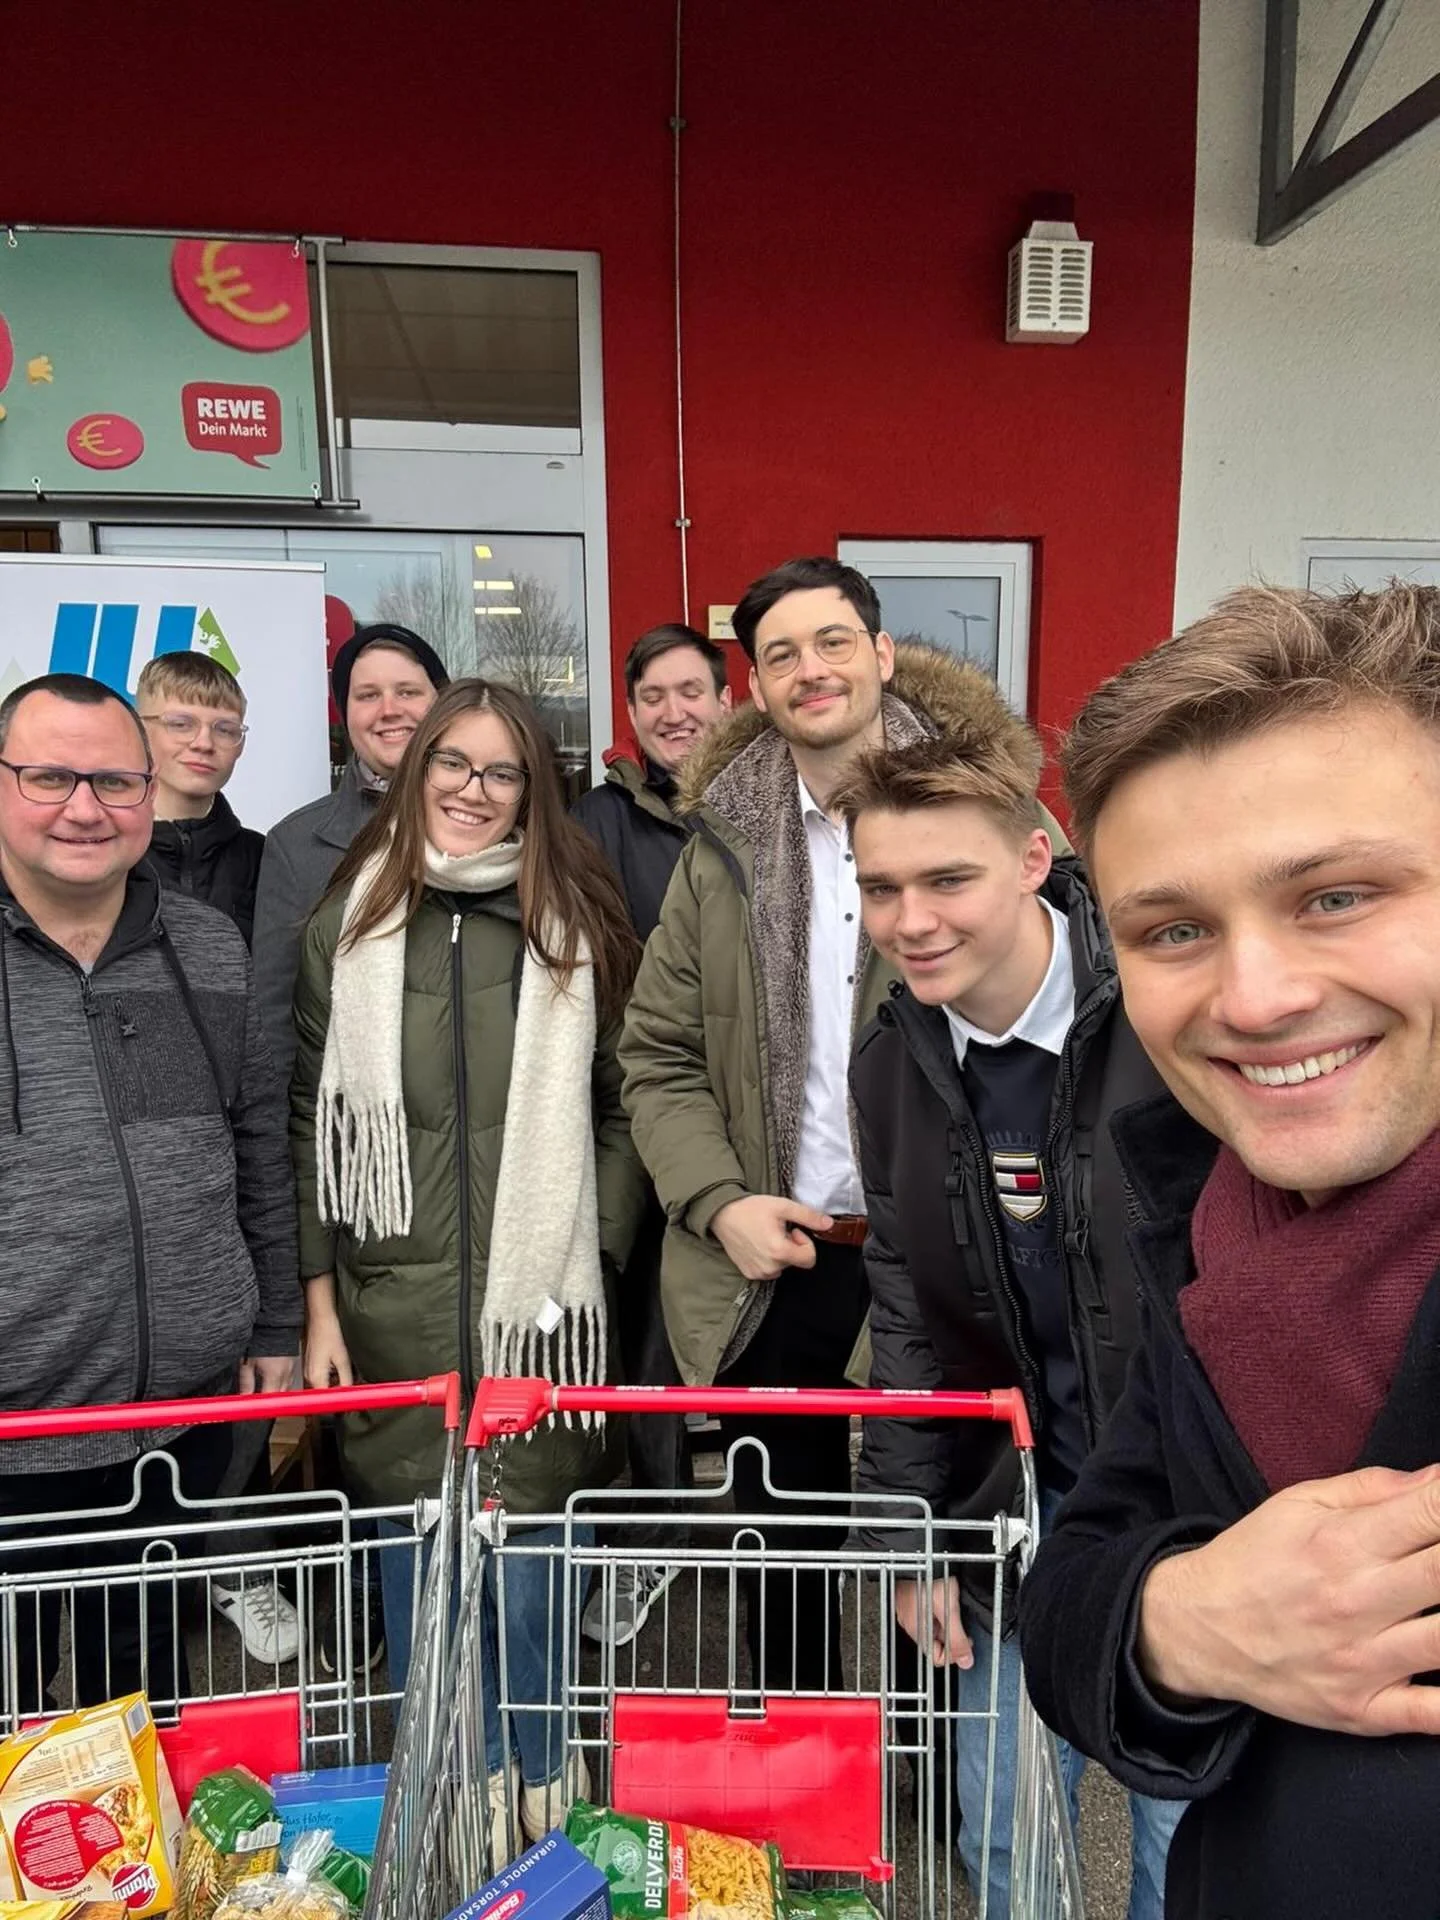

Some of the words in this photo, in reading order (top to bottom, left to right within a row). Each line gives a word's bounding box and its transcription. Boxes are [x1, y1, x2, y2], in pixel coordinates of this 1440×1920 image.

[197, 397, 266, 420] REWE
[198, 421, 227, 436] Dein
[229, 423, 268, 438] Markt
[500, 1839, 558, 1889] GIRANDOLE
[112, 1867, 157, 1902] Pfanni
[453, 1887, 501, 1920] TORSAD
